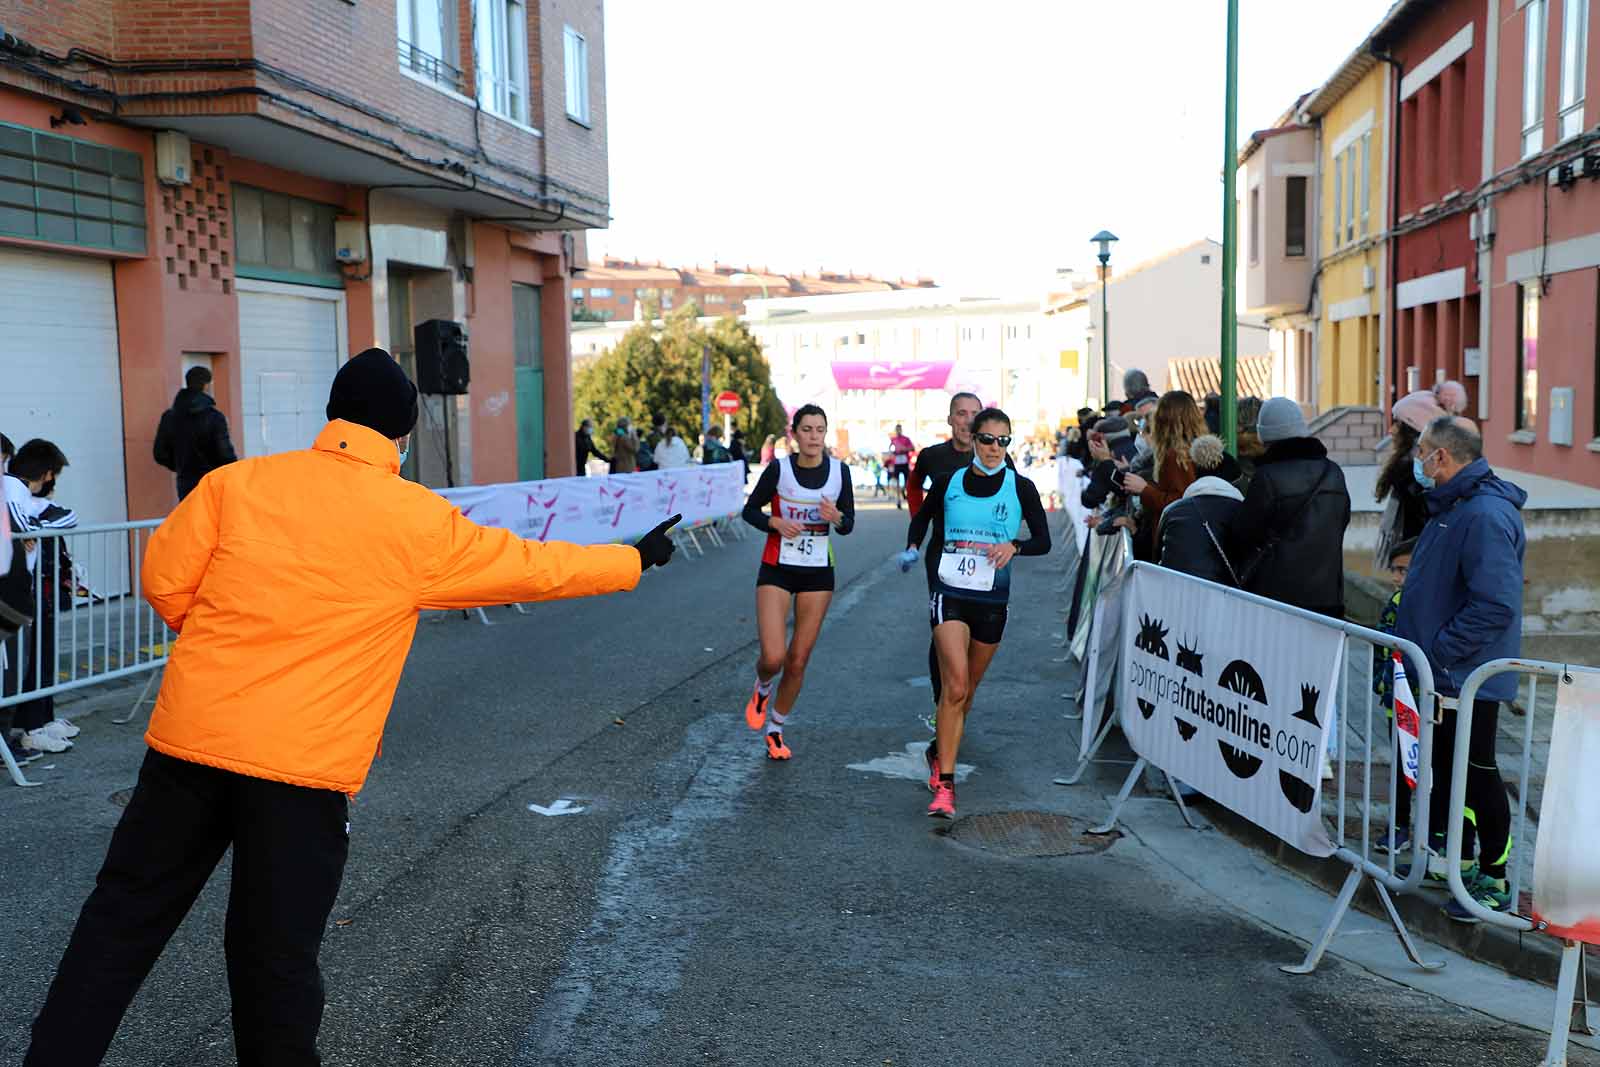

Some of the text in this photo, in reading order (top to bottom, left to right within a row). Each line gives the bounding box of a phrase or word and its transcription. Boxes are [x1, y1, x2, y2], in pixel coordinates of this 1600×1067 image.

[797, 538, 813, 556] 45
[957, 556, 976, 577] 49
[1130, 660, 1317, 770] comprafrutaonline.com
